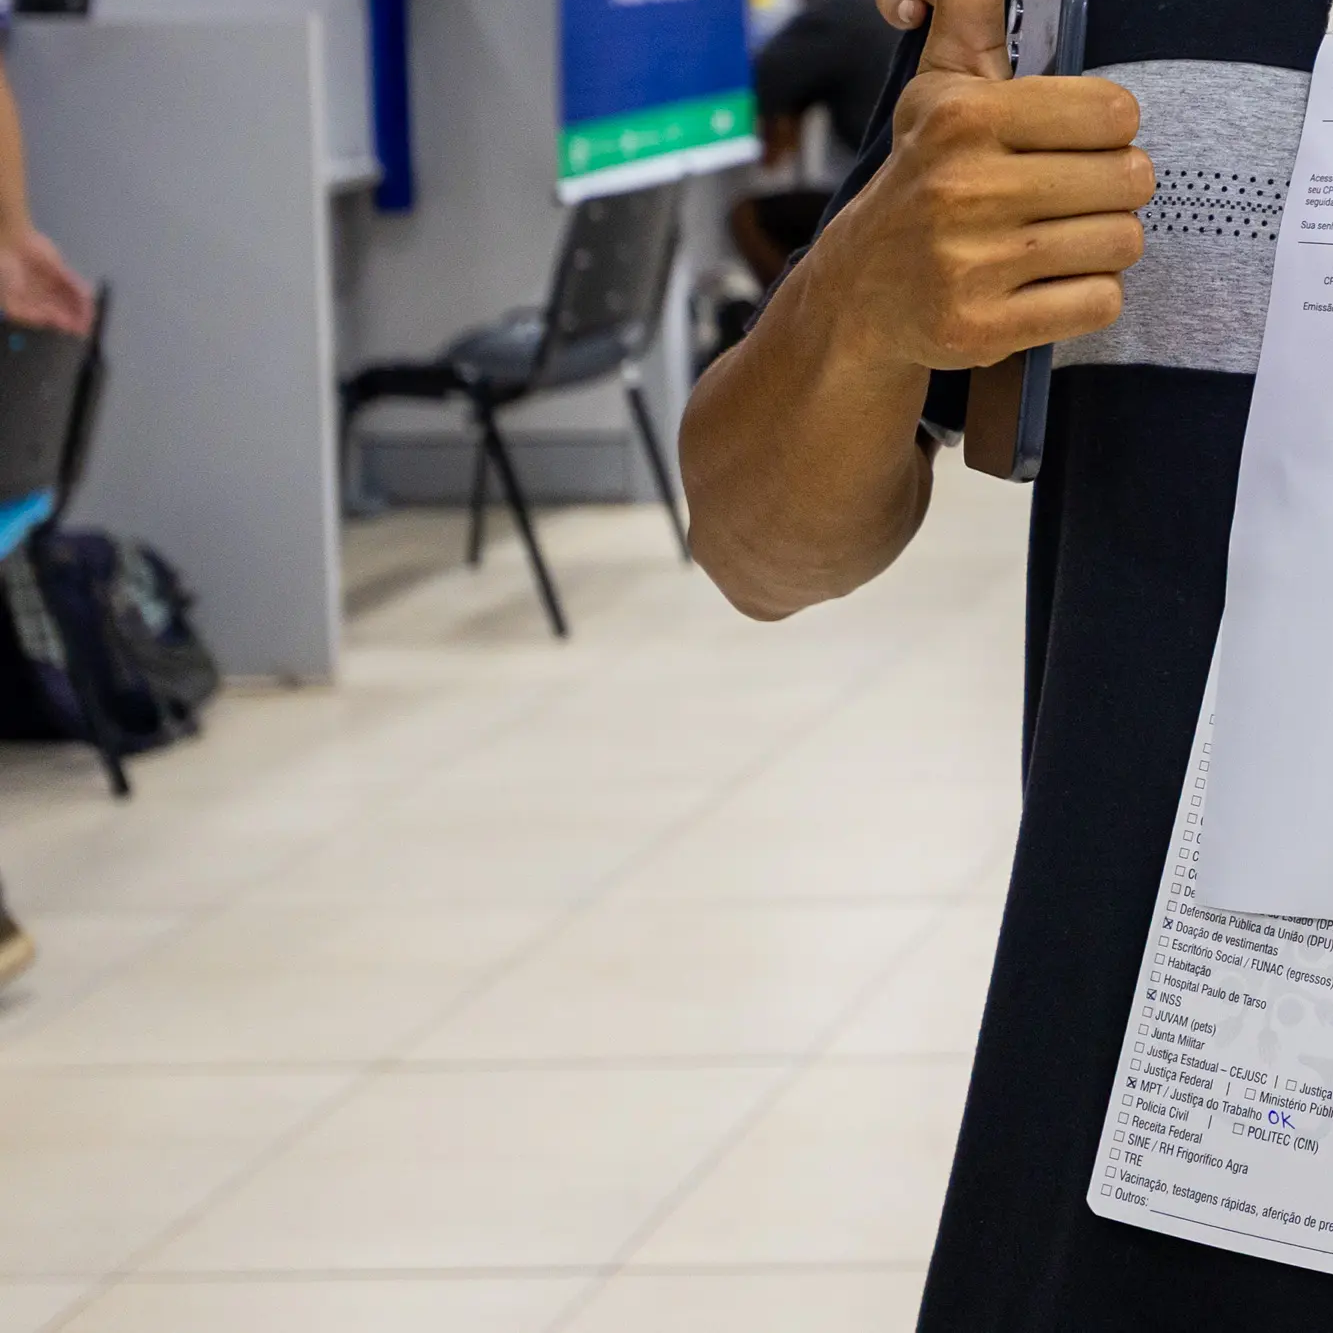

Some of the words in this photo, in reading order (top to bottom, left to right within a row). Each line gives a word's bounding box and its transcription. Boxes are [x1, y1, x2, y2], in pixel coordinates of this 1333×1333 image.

[1307, 186, 1322, 194] seu
[1300, 220, 1316, 230] Sua
[1179, 902, 1227, 926] Defensoria
[1228, 914, 1262, 934] Pública
[1263, 924, 1276, 938] da
[1277, 926, 1305, 944] União
[1175, 920, 1210, 940] Doação
[1211, 930, 1223, 943] de
[1225, 935, 1279, 956] vestimentas
[1167, 955, 1212, 977] Habitação
[1171, 938, 1214, 961] Escritório
[1214, 949, 1244, 966] Social
[1250, 957, 1284, 976] FUNAC
[1159, 990, 1182, 1007] INSS
[1163, 973, 1200, 993] Hospital
[1200, 983, 1227, 1000] Paulo
[1227, 990, 1240, 1003] de
[1242, 993, 1267, 1010] Tarso
[1154, 1009, 1189, 1028] JUVAM
[1190, 1018, 1217, 1037] (pets)
[1150, 1026, 1176, 1043] Junta
[1176, 1033, 1206, 1050] Militar
[1143, 1062, 1178, 1083] Justiça
[1178, 1070, 1214, 1090] Federal
[1146, 1045, 1179, 1065] Justiça
[1179, 1053, 1219, 1073] Estadual
[1229, 1065, 1268, 1085] CEJUSC
[1139, 1079, 1163, 1095] MPT
[1169, 1087, 1204, 1108] Justiça
[1205, 1097, 1219, 1111] do
[1222, 1100, 1263, 1121] Trabalho
[1258, 1090, 1307, 1113] Ministério
[1298, 1082, 1333, 1101] Justiça
[1135, 1096, 1167, 1117] Polícia
[1168, 1105, 1190, 1122] Civil
[1267, 1109, 1296, 1131] OK
[1131, 1114, 1167, 1135] Receita
[1167, 1124, 1203, 1144] Federal
[1246, 1125, 1291, 1147] POLITEC
[1293, 1136, 1319, 1155] (CIN)
[1124, 1150, 1144, 1167] TRE
[1127, 1132, 1152, 1150] SINE
[1158, 1141, 1175, 1156] RH
[1175, 1145, 1224, 1169] Frigorífico
[1224, 1158, 1249, 1175] Agra
[1114, 1186, 1149, 1207] Outros:
[1119, 1168, 1169, 1195] Vacinação,
[1171, 1183, 1219, 1206] testagens
[1220, 1196, 1257, 1215] rápidas,
[1261, 1206, 1302, 1225] aferição
[1303, 1214, 1317, 1228] de
